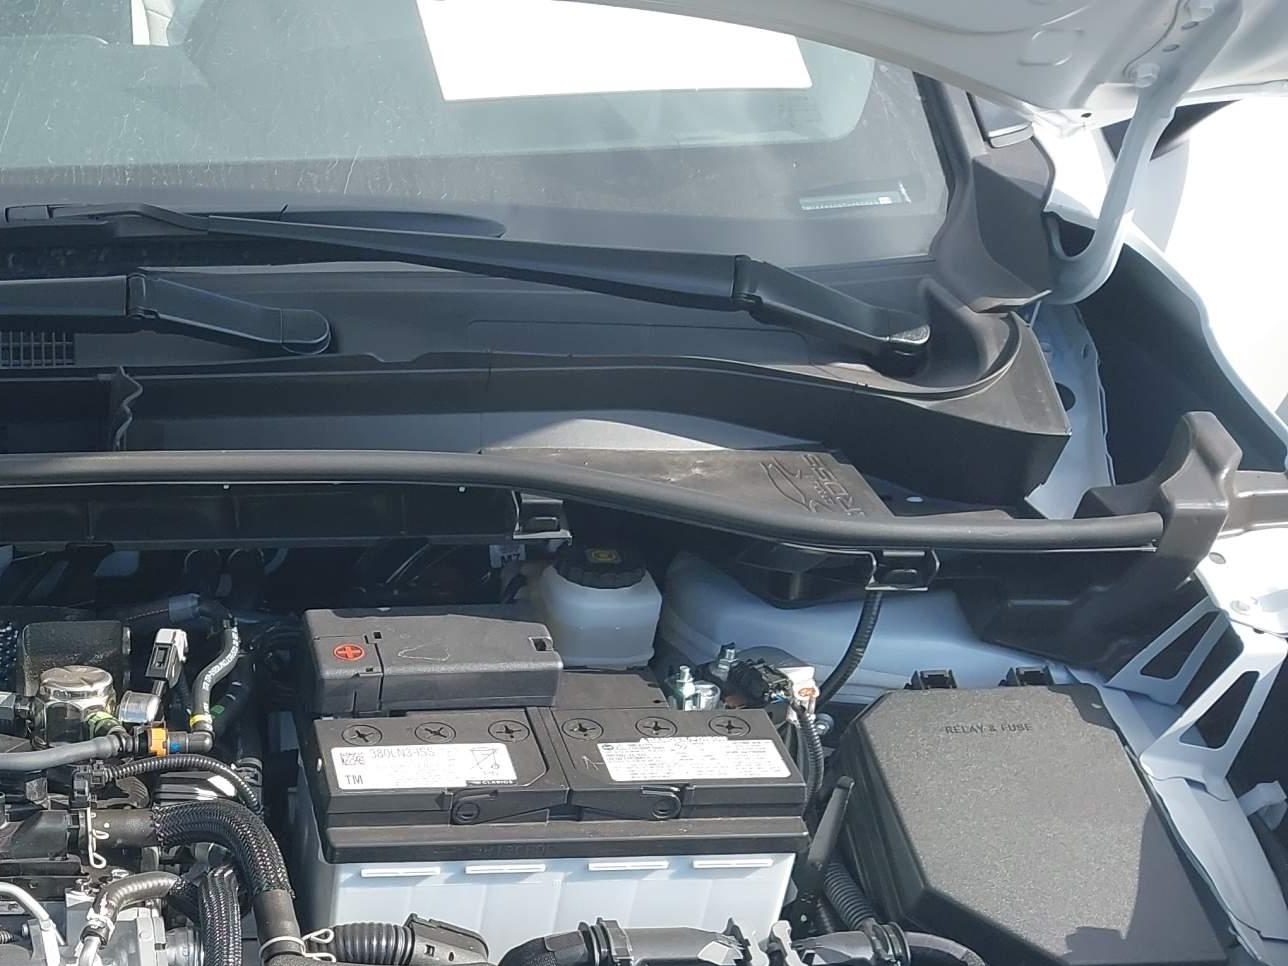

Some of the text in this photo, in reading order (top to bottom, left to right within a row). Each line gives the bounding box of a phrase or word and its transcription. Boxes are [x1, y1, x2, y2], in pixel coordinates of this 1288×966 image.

[945, 723, 1033, 735] RELAY & FUSE
[346, 774, 364, 785] TM
